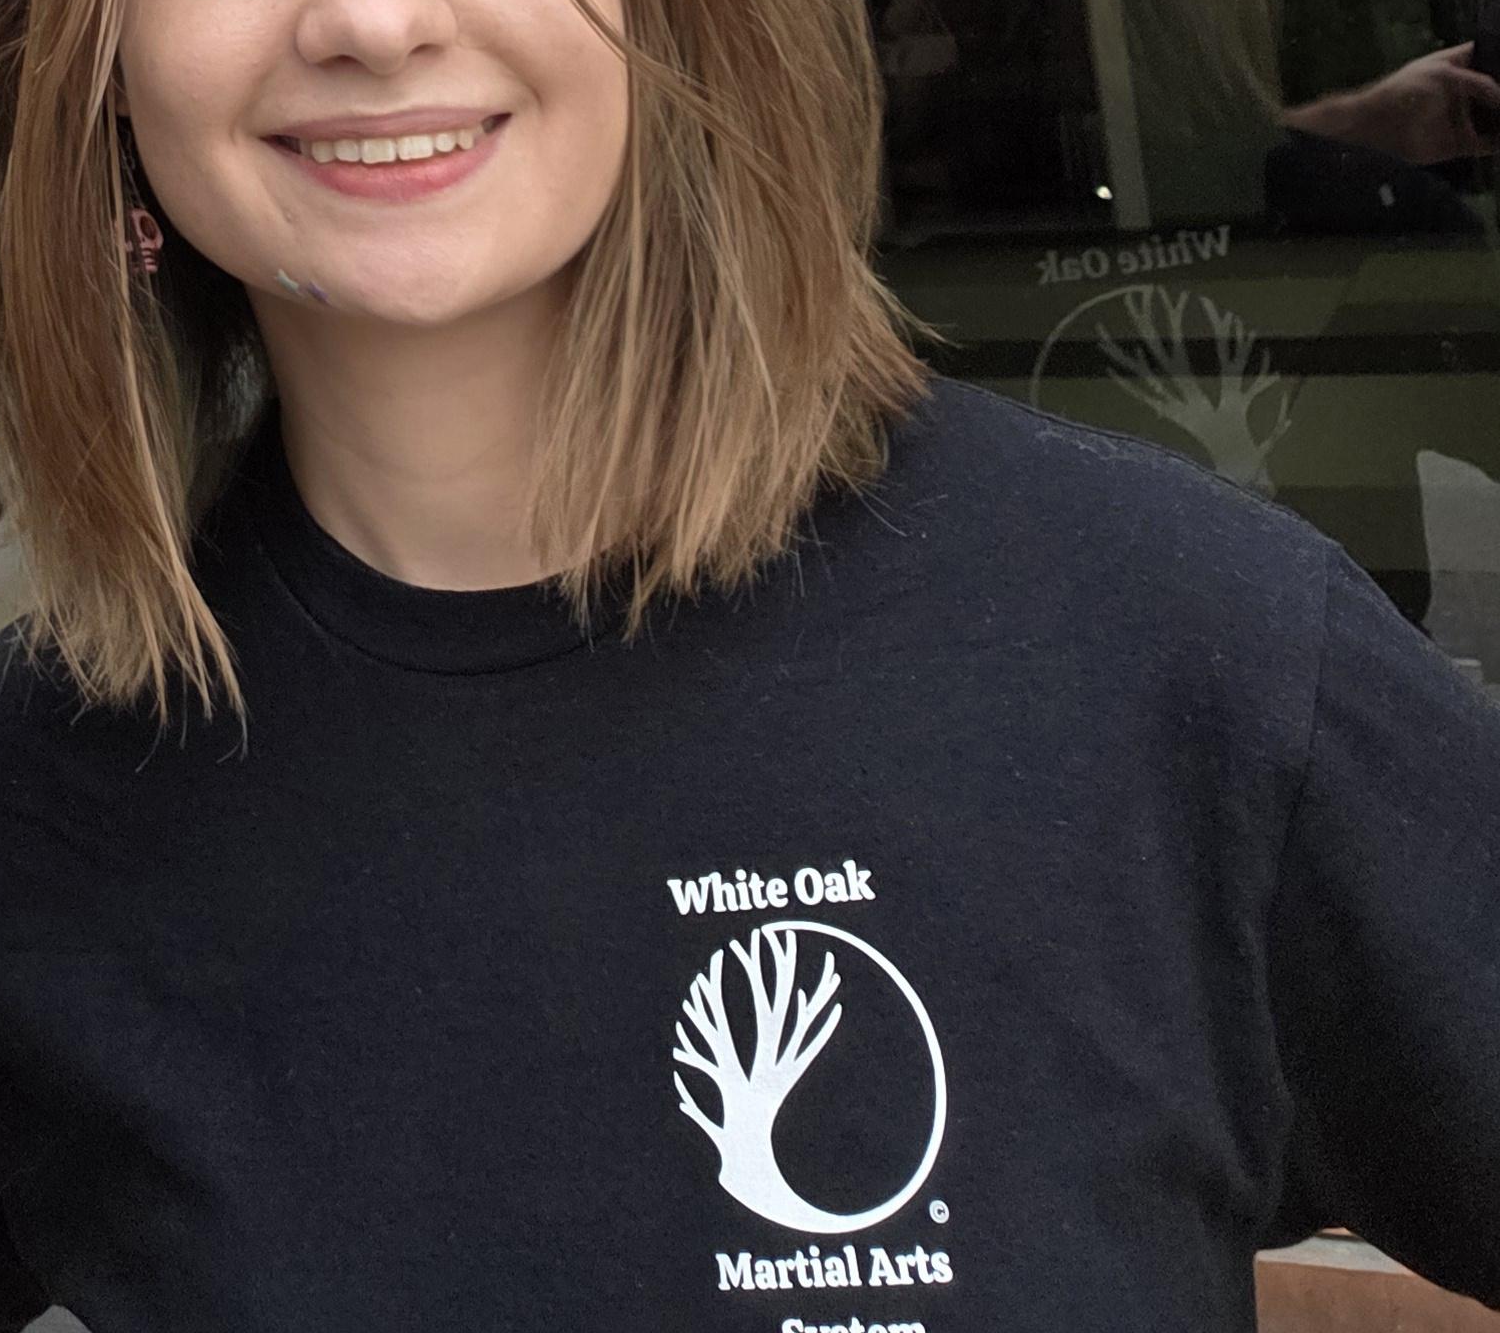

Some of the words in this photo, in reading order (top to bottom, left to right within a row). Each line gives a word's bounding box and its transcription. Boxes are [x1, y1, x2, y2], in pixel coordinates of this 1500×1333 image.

[666, 868, 790, 916] White
[793, 859, 877, 906] Oak
[715, 1244, 863, 1291] Martial
[868, 1244, 954, 1287] Arts
